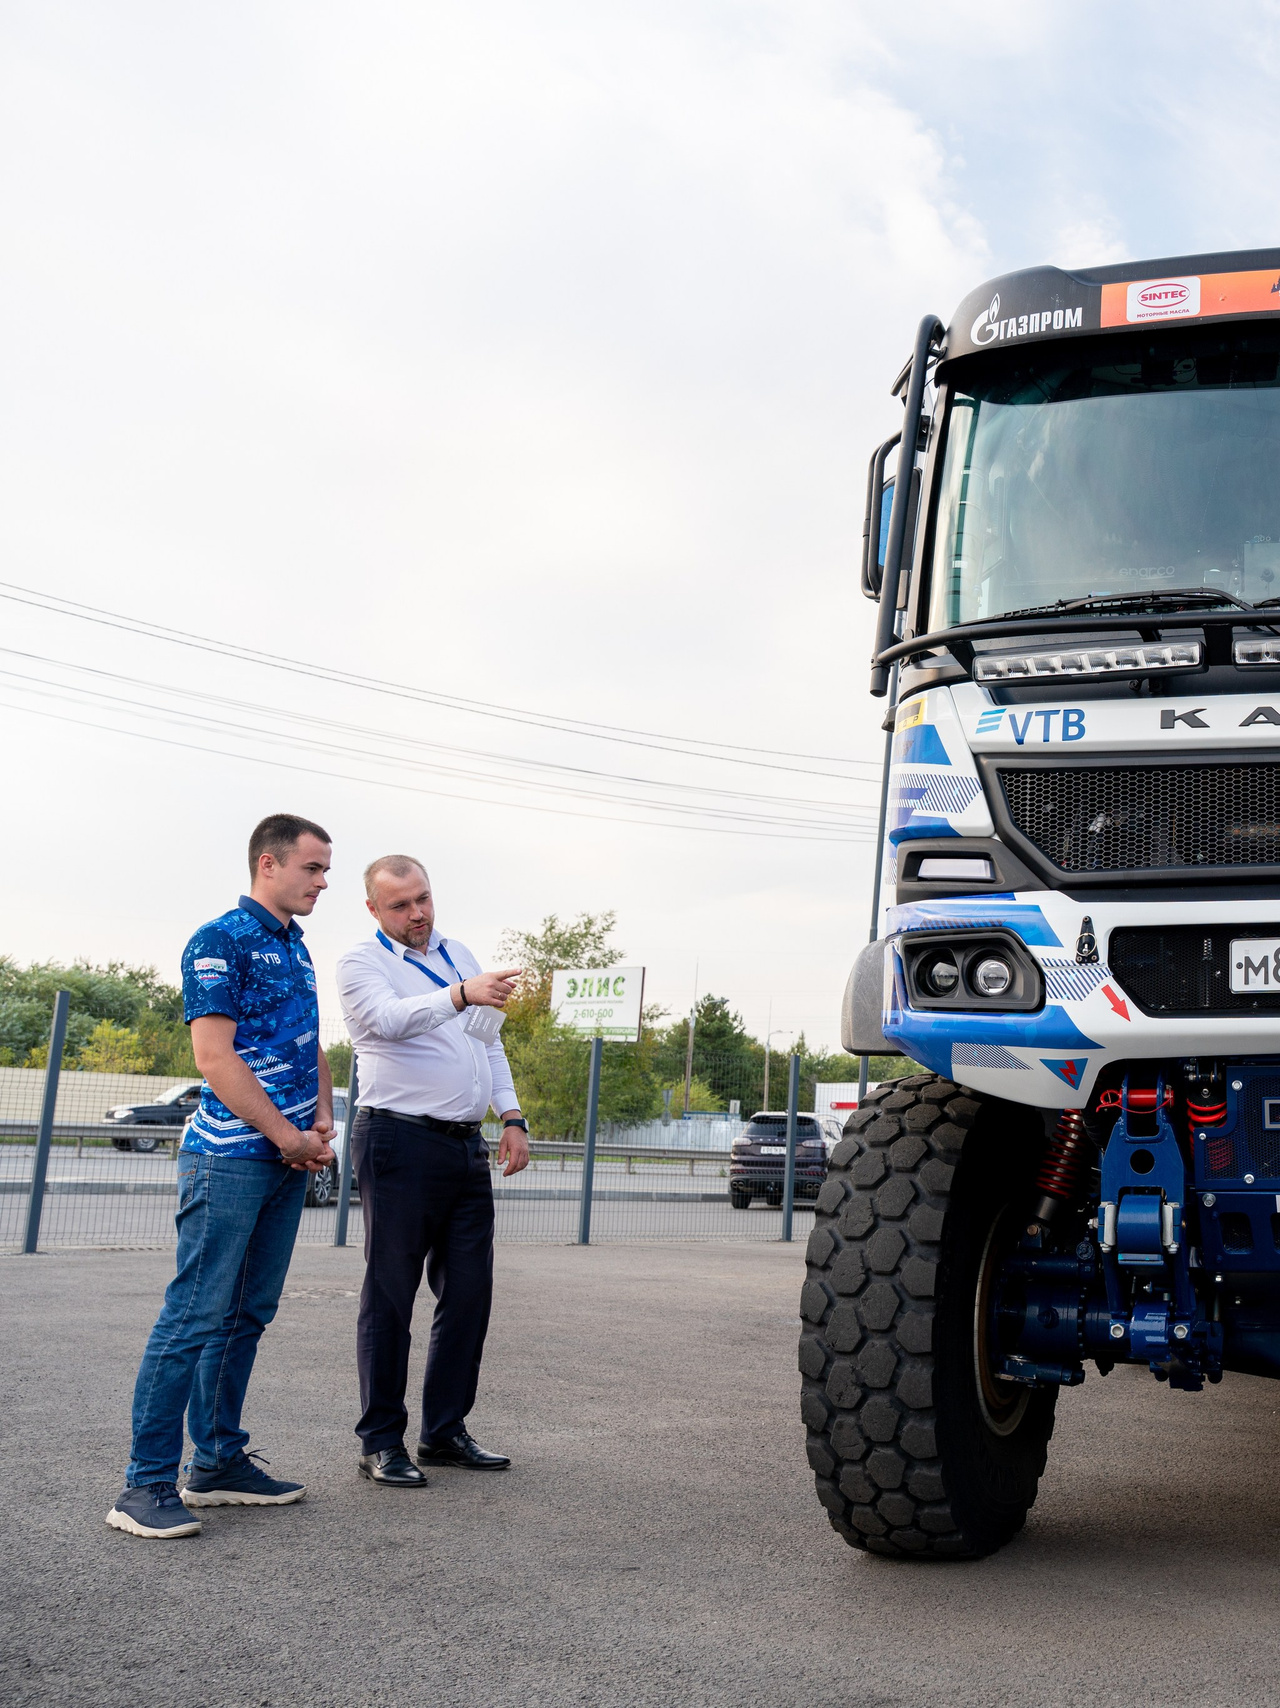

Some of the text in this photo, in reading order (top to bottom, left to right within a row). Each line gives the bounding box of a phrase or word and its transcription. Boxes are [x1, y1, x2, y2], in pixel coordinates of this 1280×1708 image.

[1141, 289, 1187, 302] SINTEC
[1136, 310, 1169, 319] МОТОРНЫЕ
[999, 307, 1083, 340] ГАЗПРОМ
[1008, 708, 1086, 746] VTB
[260, 952, 281, 965] VTB
[566, 975, 626, 999] ЭЛИС
[573, 1008, 614, 1019] 2-610-600
